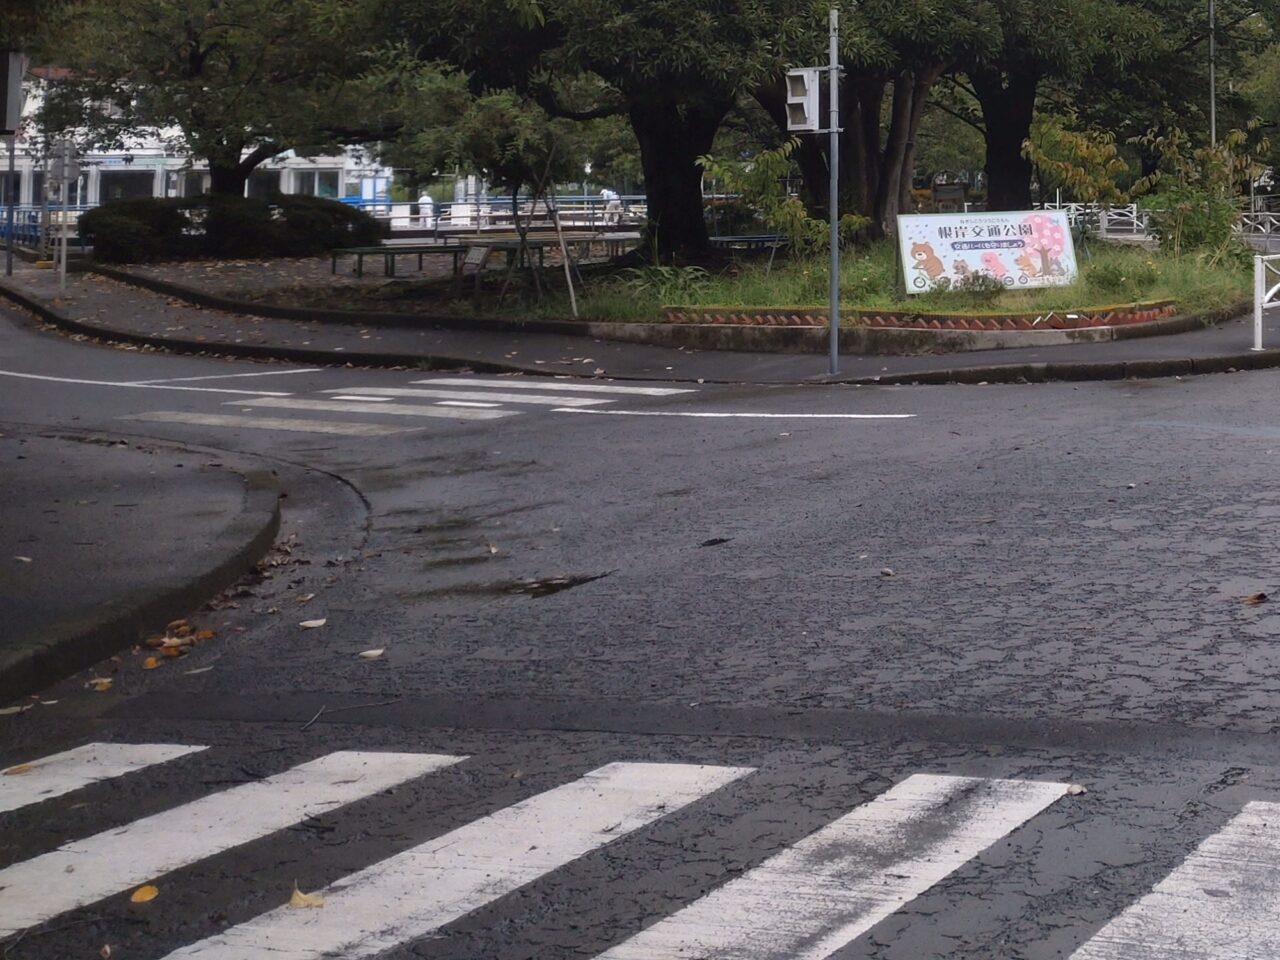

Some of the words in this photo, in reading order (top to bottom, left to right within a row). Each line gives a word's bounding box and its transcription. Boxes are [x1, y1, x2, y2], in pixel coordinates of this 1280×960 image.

[938, 224, 1033, 239] 根岸交通公園
